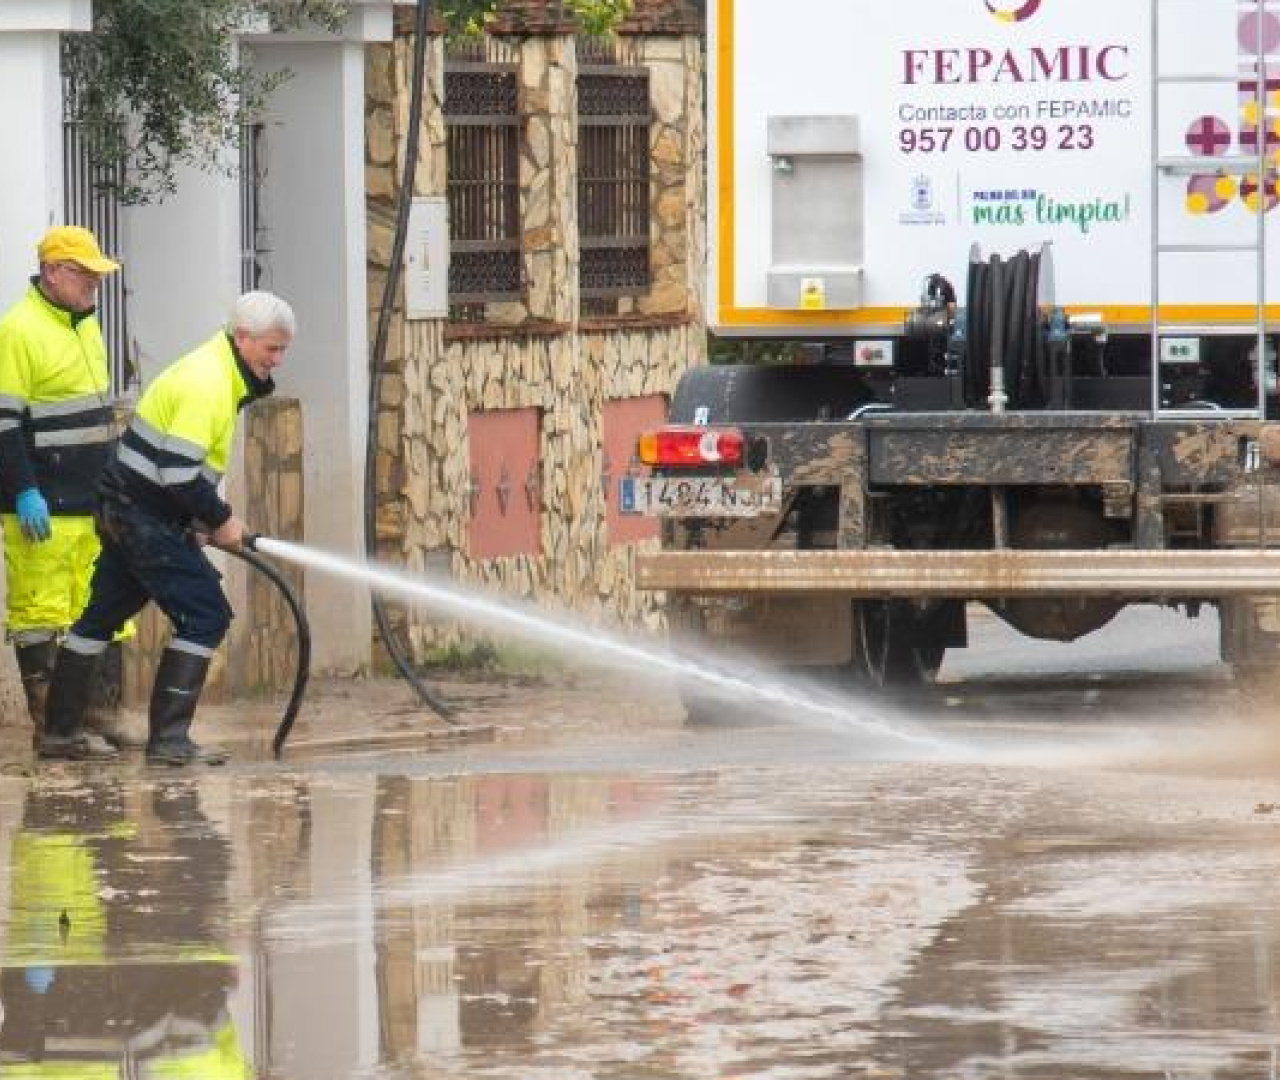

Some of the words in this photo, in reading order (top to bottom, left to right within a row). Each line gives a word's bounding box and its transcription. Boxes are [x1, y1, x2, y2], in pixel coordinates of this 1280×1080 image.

[899, 45, 1129, 85] FEPAMIC
[898, 102, 987, 122] Contacta
[992, 105, 1030, 119] con
[1036, 98, 1132, 120] FEPAMIC
[899, 127, 954, 153] 957
[964, 126, 1001, 152] 00
[1011, 124, 1048, 151] 39
[1057, 124, 1094, 150] 23
[1035, 191, 1131, 234] limpia!
